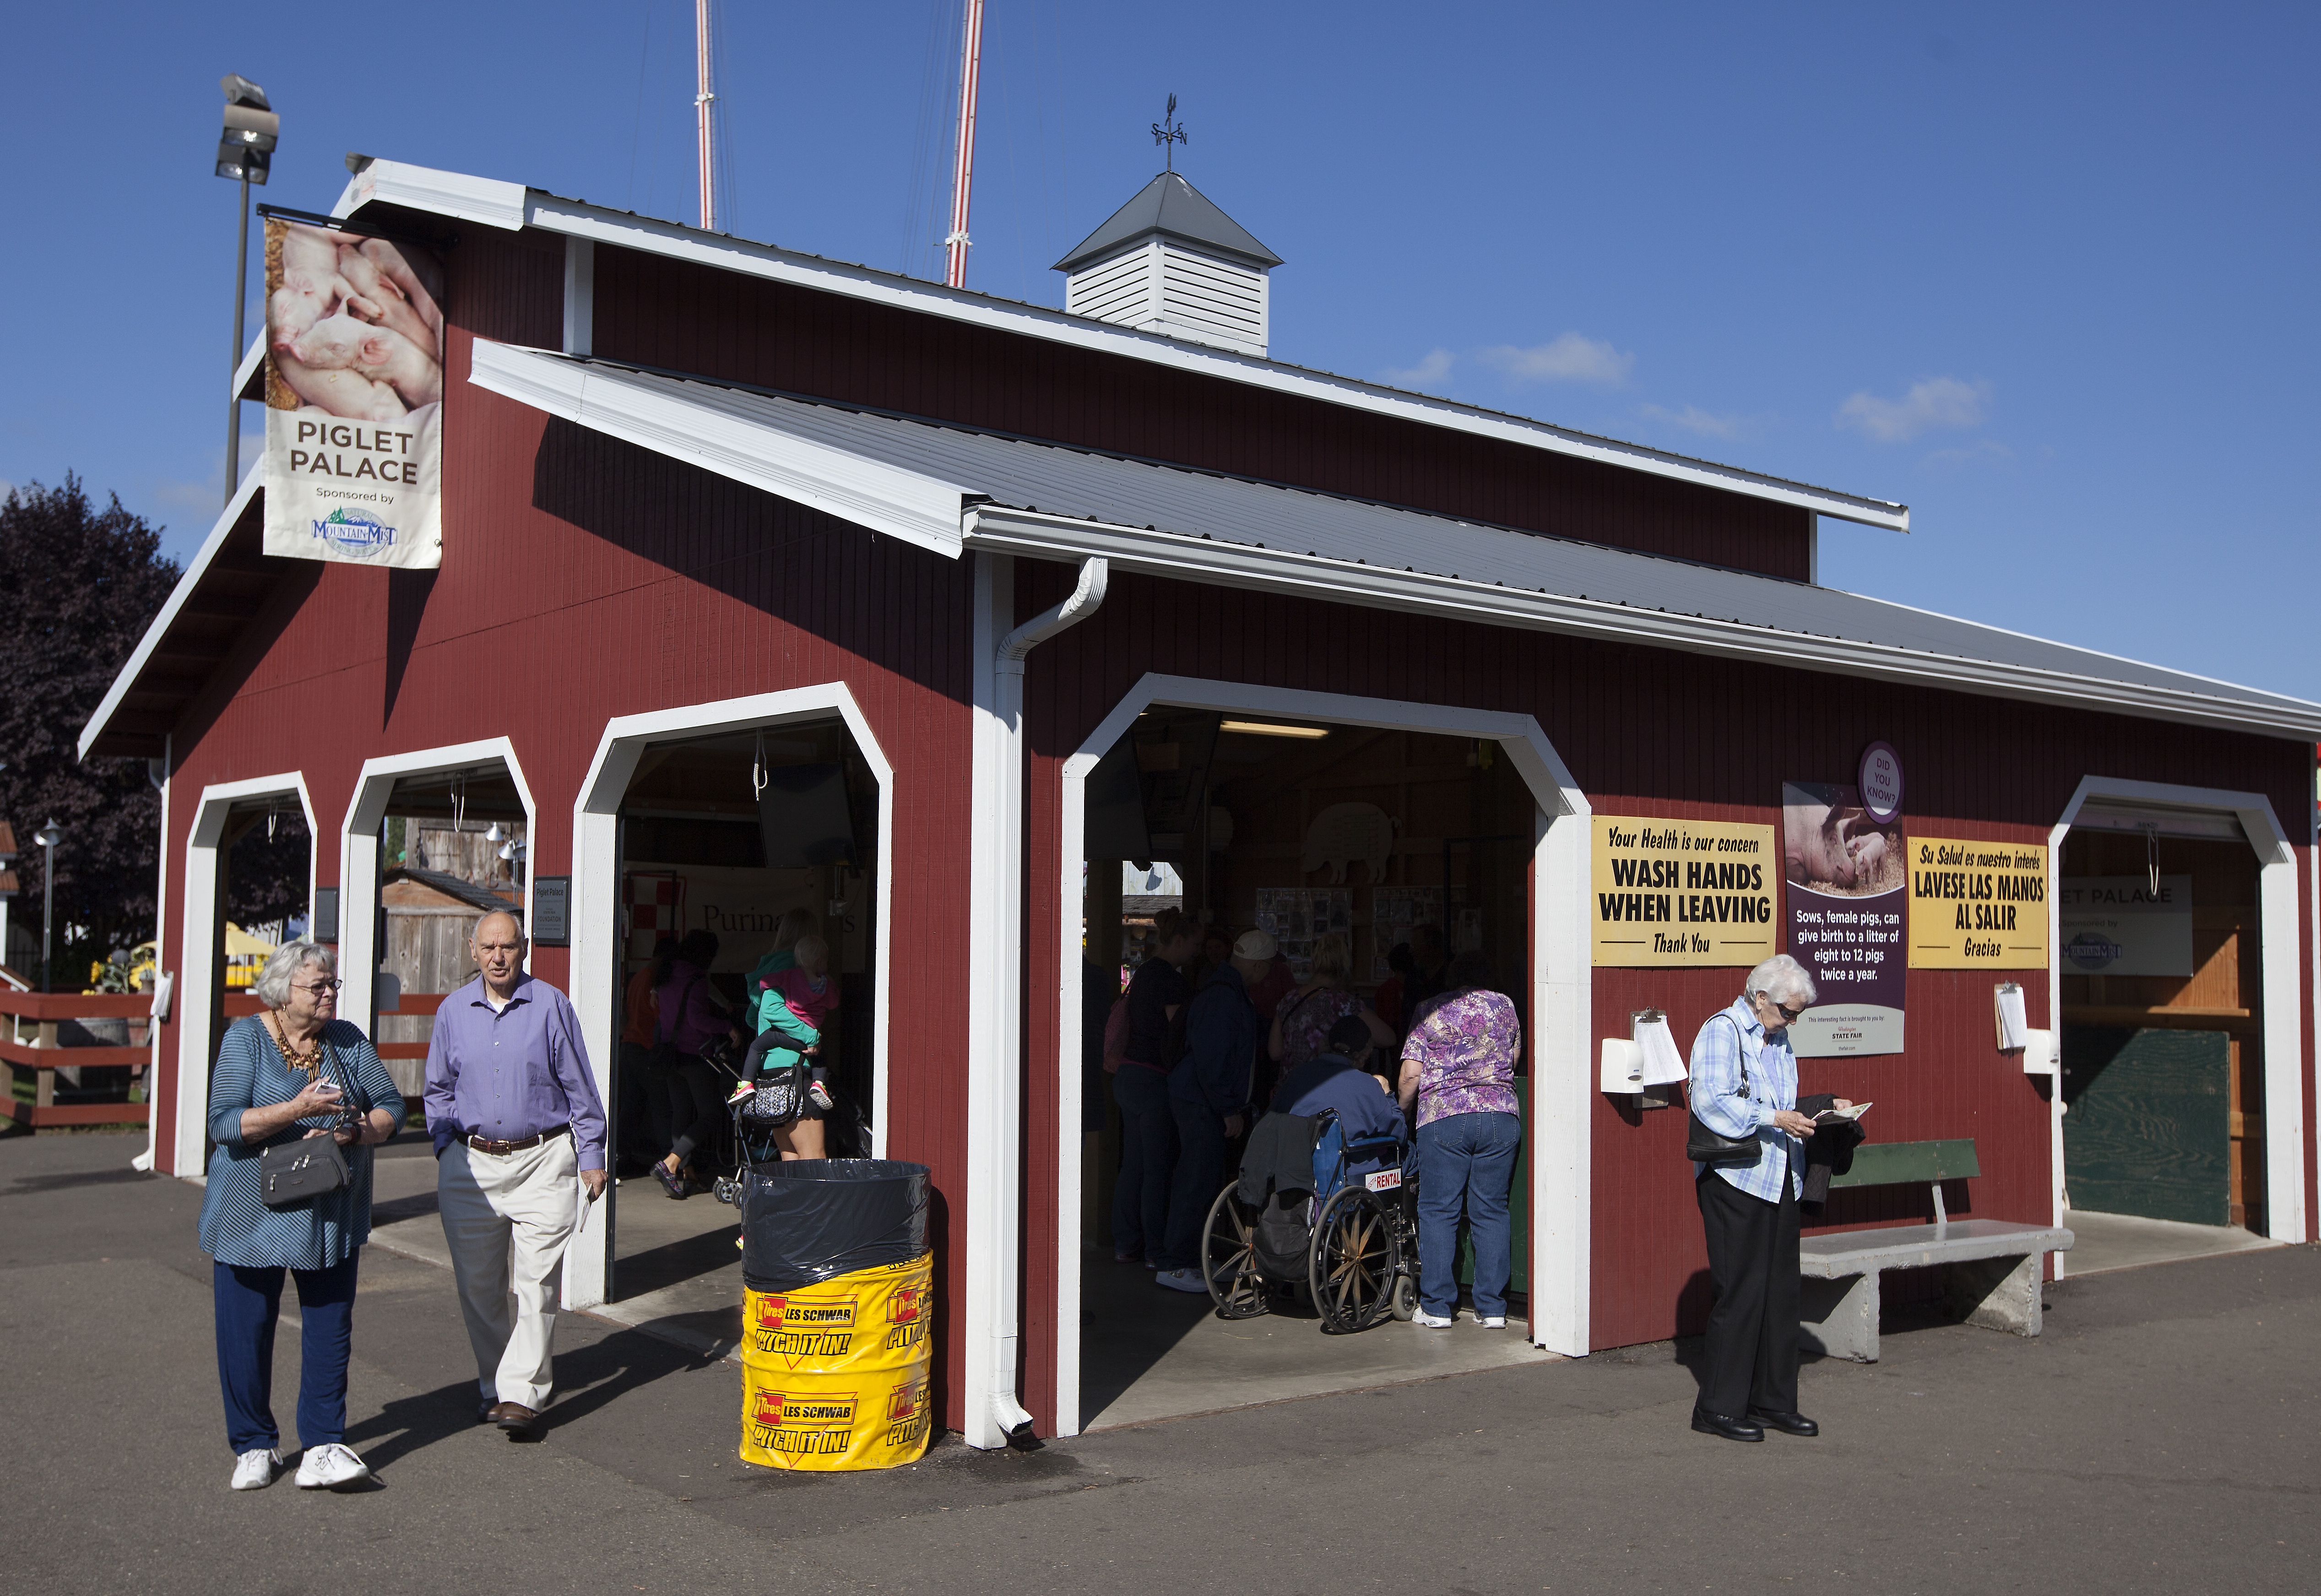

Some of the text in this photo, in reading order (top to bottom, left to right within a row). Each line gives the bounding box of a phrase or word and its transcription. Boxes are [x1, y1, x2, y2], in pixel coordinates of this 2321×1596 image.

[298, 421, 413, 454] PIGLET
[291, 449, 418, 485] PALACE
[316, 487, 394, 505] Sponsored by
[1876, 758, 1890, 770] DID
[1875, 772, 1890, 786] YOU
[1867, 785, 1895, 803] KNOW?
[1609, 826, 1759, 853] Your Health is our concern
[1920, 844, 2040, 870] Su Salud es nuestro interés
[1611, 858, 1762, 890] WASH HANDS
[537, 888, 564, 897] Piglet Palace
[1915, 871, 1965, 899] LAVESE
[1969, 873, 1992, 900] LAS
[1997, 875, 2044, 902] MANOS
[2091, 888, 2172, 904] PALACE
[1598, 893, 1771, 923] WHEN LEAVING
[1955, 903, 2016, 930] AL SALIR
[1796, 910, 1899, 927] Sows, female pigs, can
[2062, 919, 2118, 928] Sponsored by
[1654, 932, 1710, 953] Thank You
[1798, 929, 1899, 945] give birth to a litter of
[1814, 948, 1884, 964] eight to 12 pigs
[1964, 937, 2001, 957] Gracias
[1821, 967, 1877, 983] twice a year.
[1377, 1172, 1400, 1188] RENTAL
[764, 1301, 784, 1319] Tires
[785, 1308, 851, 1321] LES SCHWAB
[898, 1296, 916, 1315] Tires
[755, 1329, 852, 1356] PITCH IT IN!
[760, 1397, 781, 1415] Tires
[897, 1393, 913, 1411] Tires
[783, 1406, 851, 1418] LES SCHWAB
[754, 1424, 851, 1454] PITCH IT IN!
